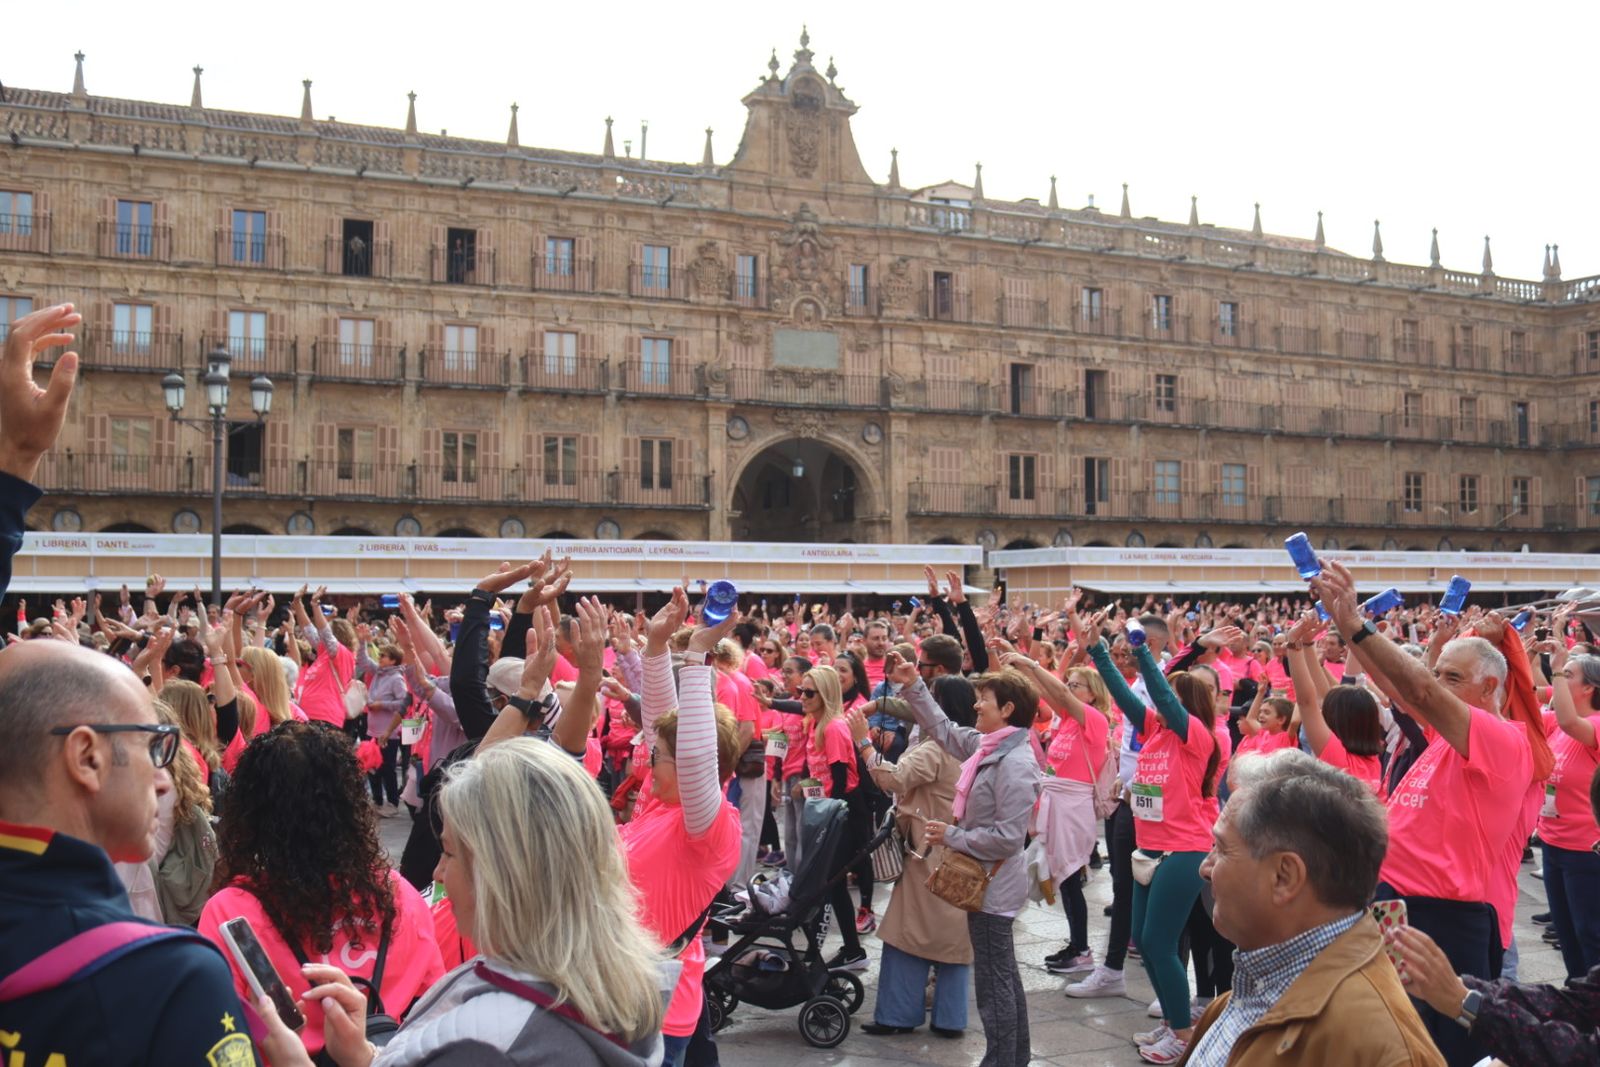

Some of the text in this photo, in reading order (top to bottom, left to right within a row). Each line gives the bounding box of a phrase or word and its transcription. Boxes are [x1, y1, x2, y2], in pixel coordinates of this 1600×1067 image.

[97, 540, 128, 548] DANTE
[599, 546, 643, 554] ANTICUARIA
[649, 547, 684, 555] LEYENDA
[1140, 761, 1156, 771] tra
